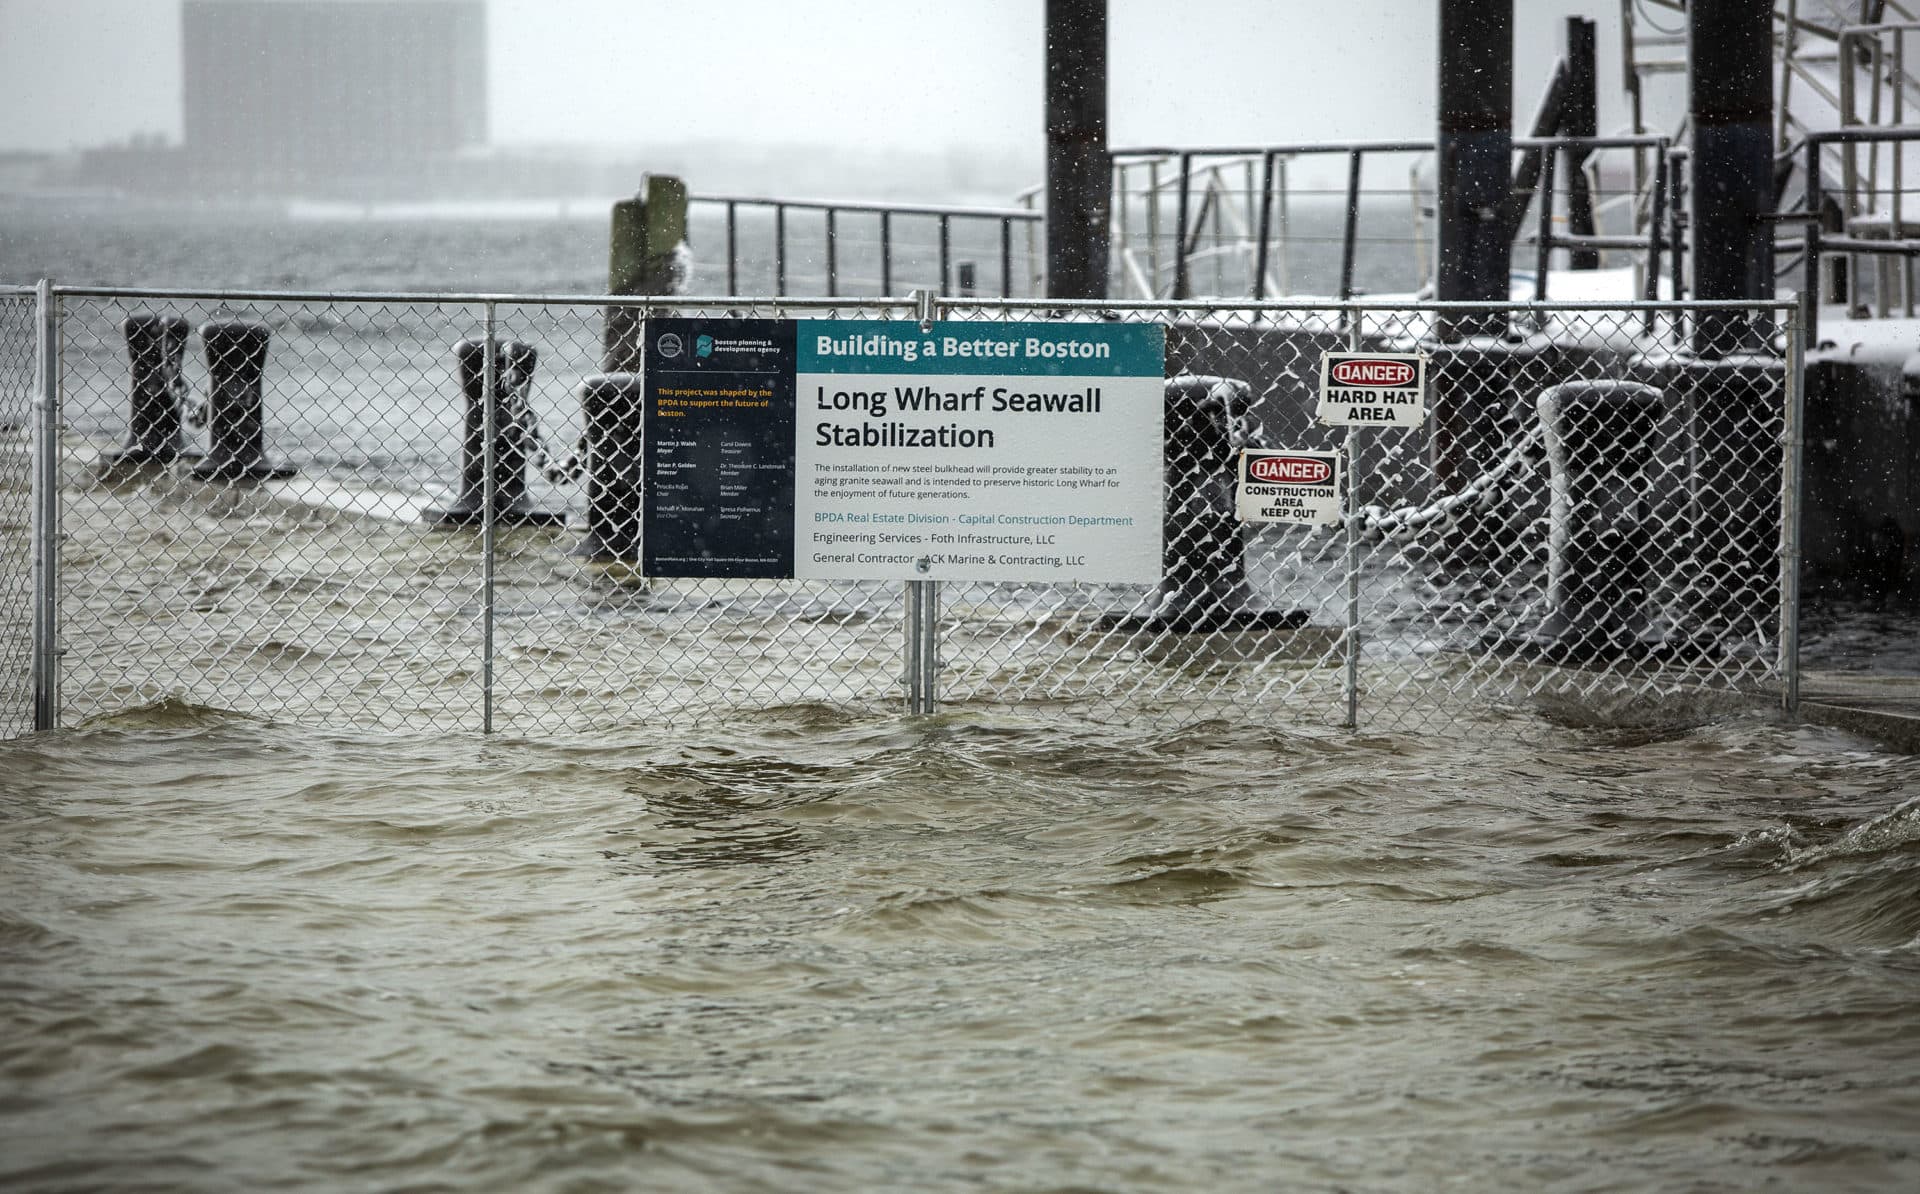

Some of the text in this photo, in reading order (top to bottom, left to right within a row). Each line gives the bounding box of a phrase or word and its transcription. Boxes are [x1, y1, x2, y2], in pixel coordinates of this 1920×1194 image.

[817, 335, 1110, 361] Building a Better Boston
[1338, 365, 1410, 382] DANGER
[658, 388, 673, 396] This
[674, 389, 701, 397] project
[719, 389, 747, 397] shaped
[747, 389, 758, 397] by
[759, 389, 773, 397] the
[1327, 390, 1419, 405] HARD HAT
[690, 400, 719, 408] support
[818, 386, 1101, 417] Long Wharf Seawall
[1347, 408, 1396, 421] AREA
[816, 422, 994, 448] Stabilization
[815, 464, 830, 472] The
[832, 464, 879, 473] installation
[881, 464, 891, 473] of
[912, 464, 933, 473] steel
[935, 464, 974, 473] bulkhead
[976, 464, 991, 473] will
[992, 465, 1025, 475] provide
[1027, 466, 1058, 476] greater
[1059, 466, 1093, 476] stability
[1095, 466, 1104, 475] to
[1256, 462, 1326, 478] DANGER
[814, 477, 1120, 489] aging granite seawall and is intended to preserve historic Long Wharf for
[814, 489, 970, 500] the enjoyment of future generations.
[1245, 486, 1334, 498] CONSTRUCTION
[1274, 497, 1304, 507] AREA
[814, 512, 844, 523] BPDA
[847, 512, 870, 523] Real
[872, 513, 905, 523] Estate
[907, 513, 949, 524] Division
[958, 513, 995, 526] Capital
[997, 514, 1066, 525] Construction
[1068, 515, 1134, 528] Department
[1261, 508, 1317, 519] KEEP OUT
[813, 532, 876, 545] Engineering
[878, 532, 922, 544] Services
[931, 533, 955, 544] Foth
[957, 533, 1033, 546] Infrastructure,
[1036, 534, 1056, 545] LLC
[813, 552, 855, 564] General
[857, 553, 914, 564] Contractor
[924, 554, 945, 564] ACK
[947, 554, 985, 565] Marine
[987, 555, 997, 565] &
[999, 554, 1063, 568] Contracting,
[1066, 556, 1085, 566] LLC
